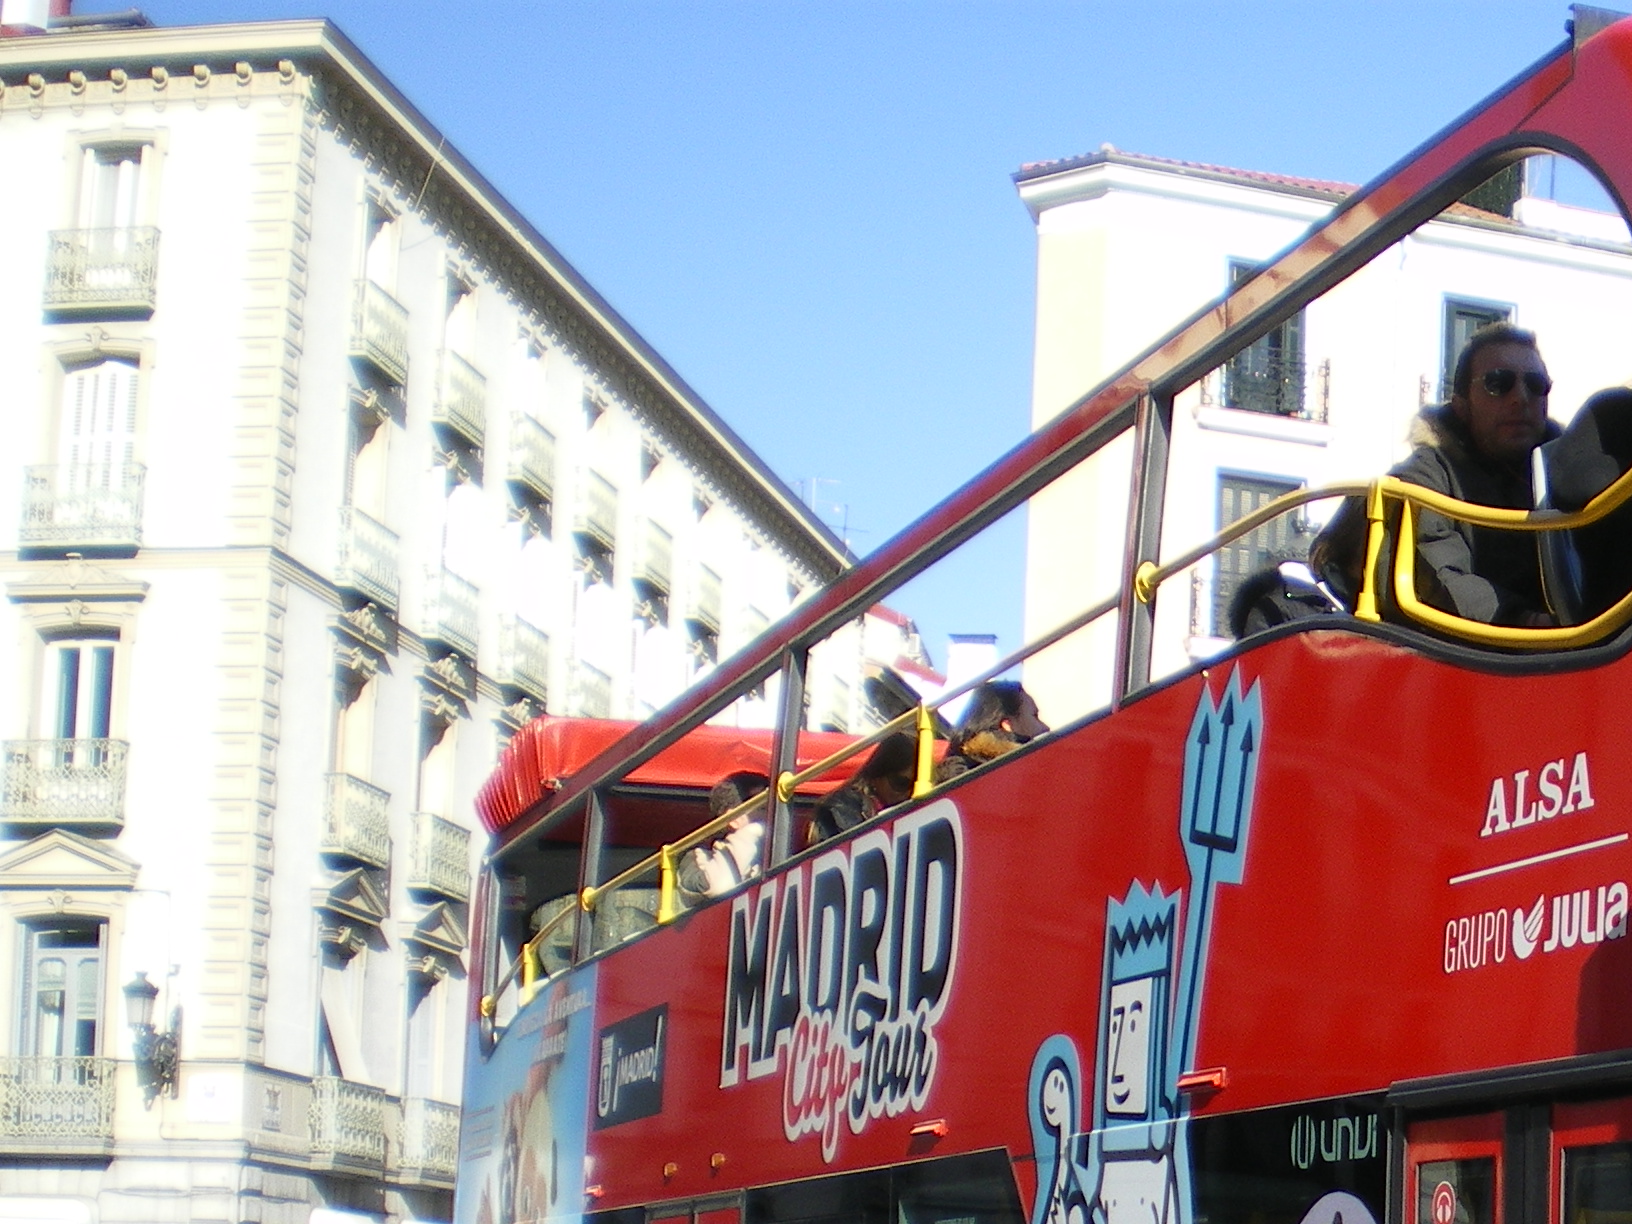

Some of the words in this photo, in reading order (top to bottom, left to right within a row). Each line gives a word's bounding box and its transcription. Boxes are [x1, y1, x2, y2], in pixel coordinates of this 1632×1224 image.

[1480, 751, 1595, 837] ALSA
[720, 799, 962, 1088] MADRID
[1444, 908, 1508, 974] GRUPO
[785, 1010, 850, 1163] City
[848, 985, 937, 1134] Tour
